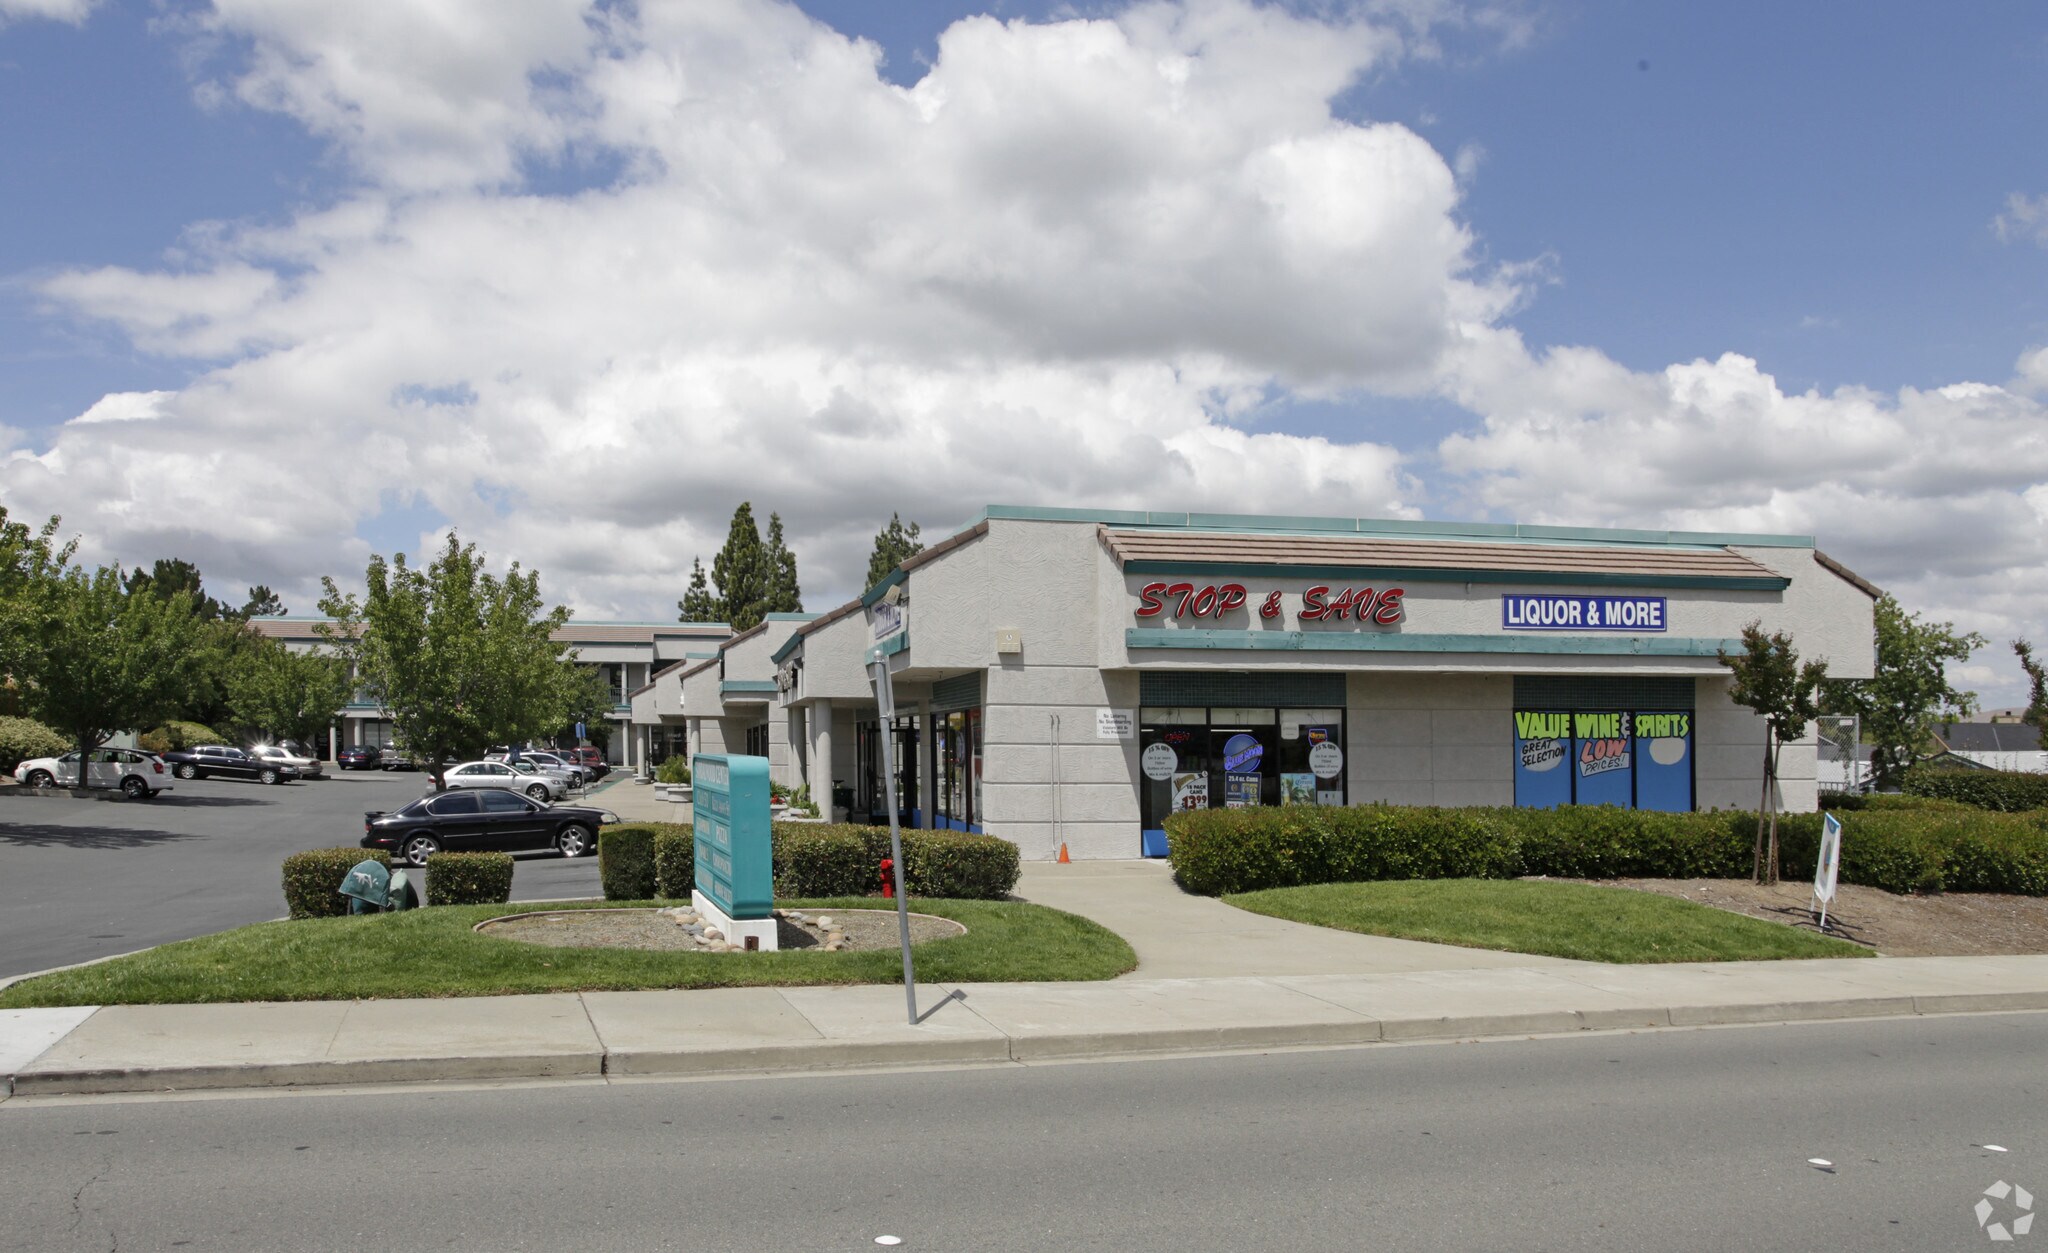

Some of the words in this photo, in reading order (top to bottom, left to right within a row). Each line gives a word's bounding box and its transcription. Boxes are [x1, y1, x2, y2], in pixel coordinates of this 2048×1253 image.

[1135, 582, 1248, 619] STOP
[1260, 590, 1283, 618] &
[1298, 586, 1405, 625] SAVE
[1507, 599, 1582, 626] LIQUOR
[1586, 600, 1600, 625] &
[1605, 601, 1662, 626] MORE
[1164, 732, 1191, 742] OPEN
[1514, 711, 1571, 740] VALUE
[1574, 713, 1620, 739] WINE
[1635, 713, 1690, 739] SPIRITS
[1521, 740, 1553, 754] GREAT
[1521, 745, 1567, 767] SELECTION
[1580, 738, 1628, 765] LOW
[1584, 757, 1625, 775] PRICES!
